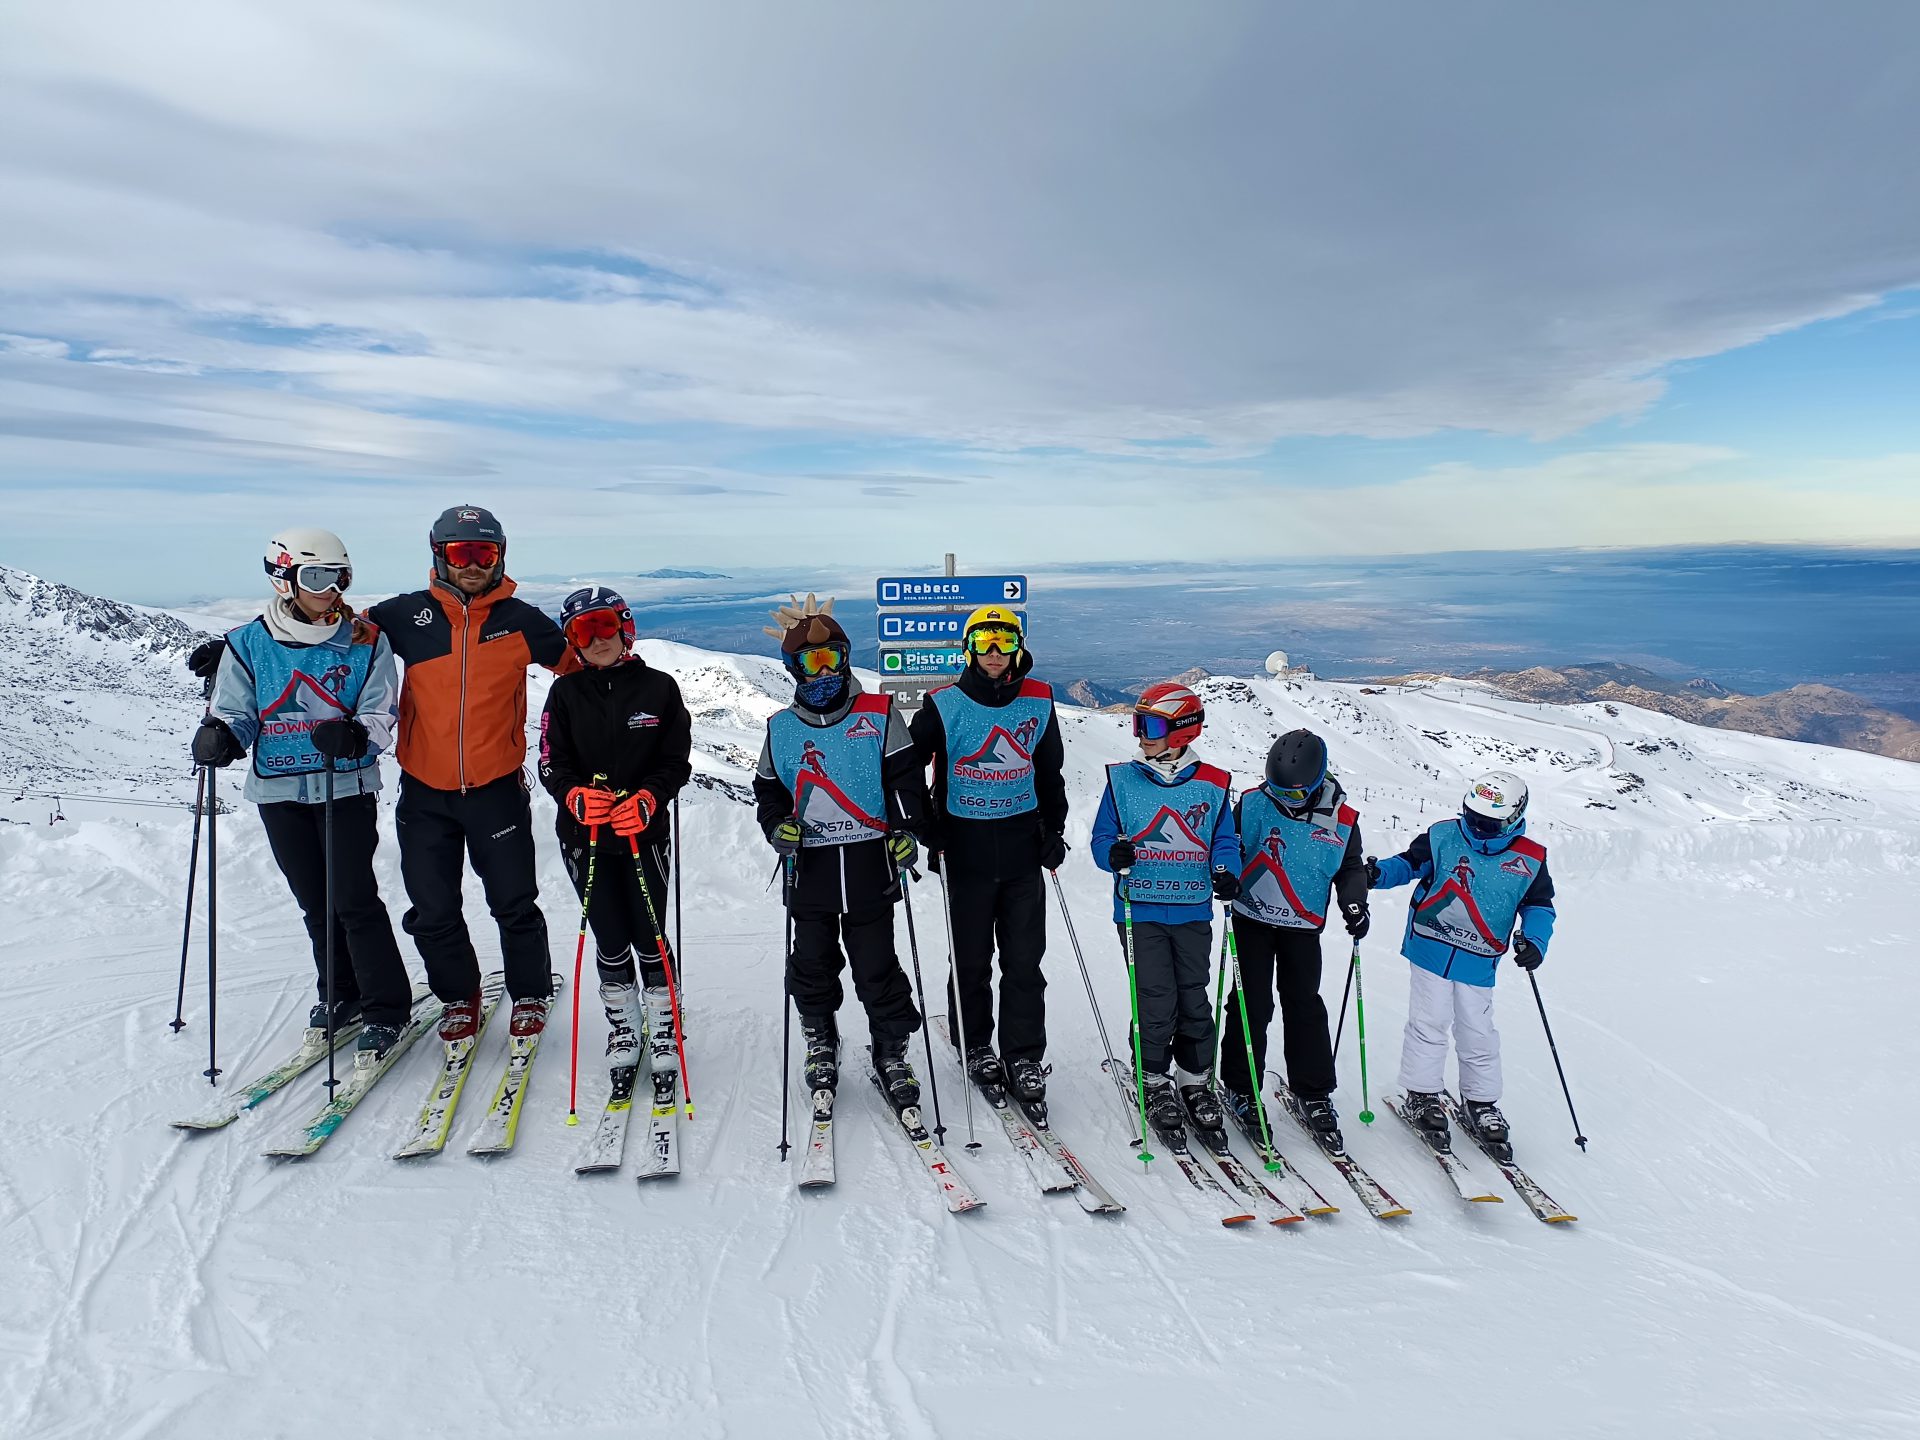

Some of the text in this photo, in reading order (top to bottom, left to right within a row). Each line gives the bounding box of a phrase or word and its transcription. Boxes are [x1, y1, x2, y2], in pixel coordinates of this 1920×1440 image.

[903, 583, 960, 594] Rebeco
[904, 620, 958, 632] Zorro
[906, 652, 966, 665] Pista de
[1175, 715, 1198, 727] SMITH
[266, 755, 296, 768] 660
[959, 795, 986, 807] 660
[989, 798, 1013, 809] 578
[827, 820, 854, 833] 578
[1155, 880, 1180, 891] 578
[1183, 881, 1206, 891] 705
[1266, 904, 1290, 918] 578
[1454, 927, 1478, 942] 578
